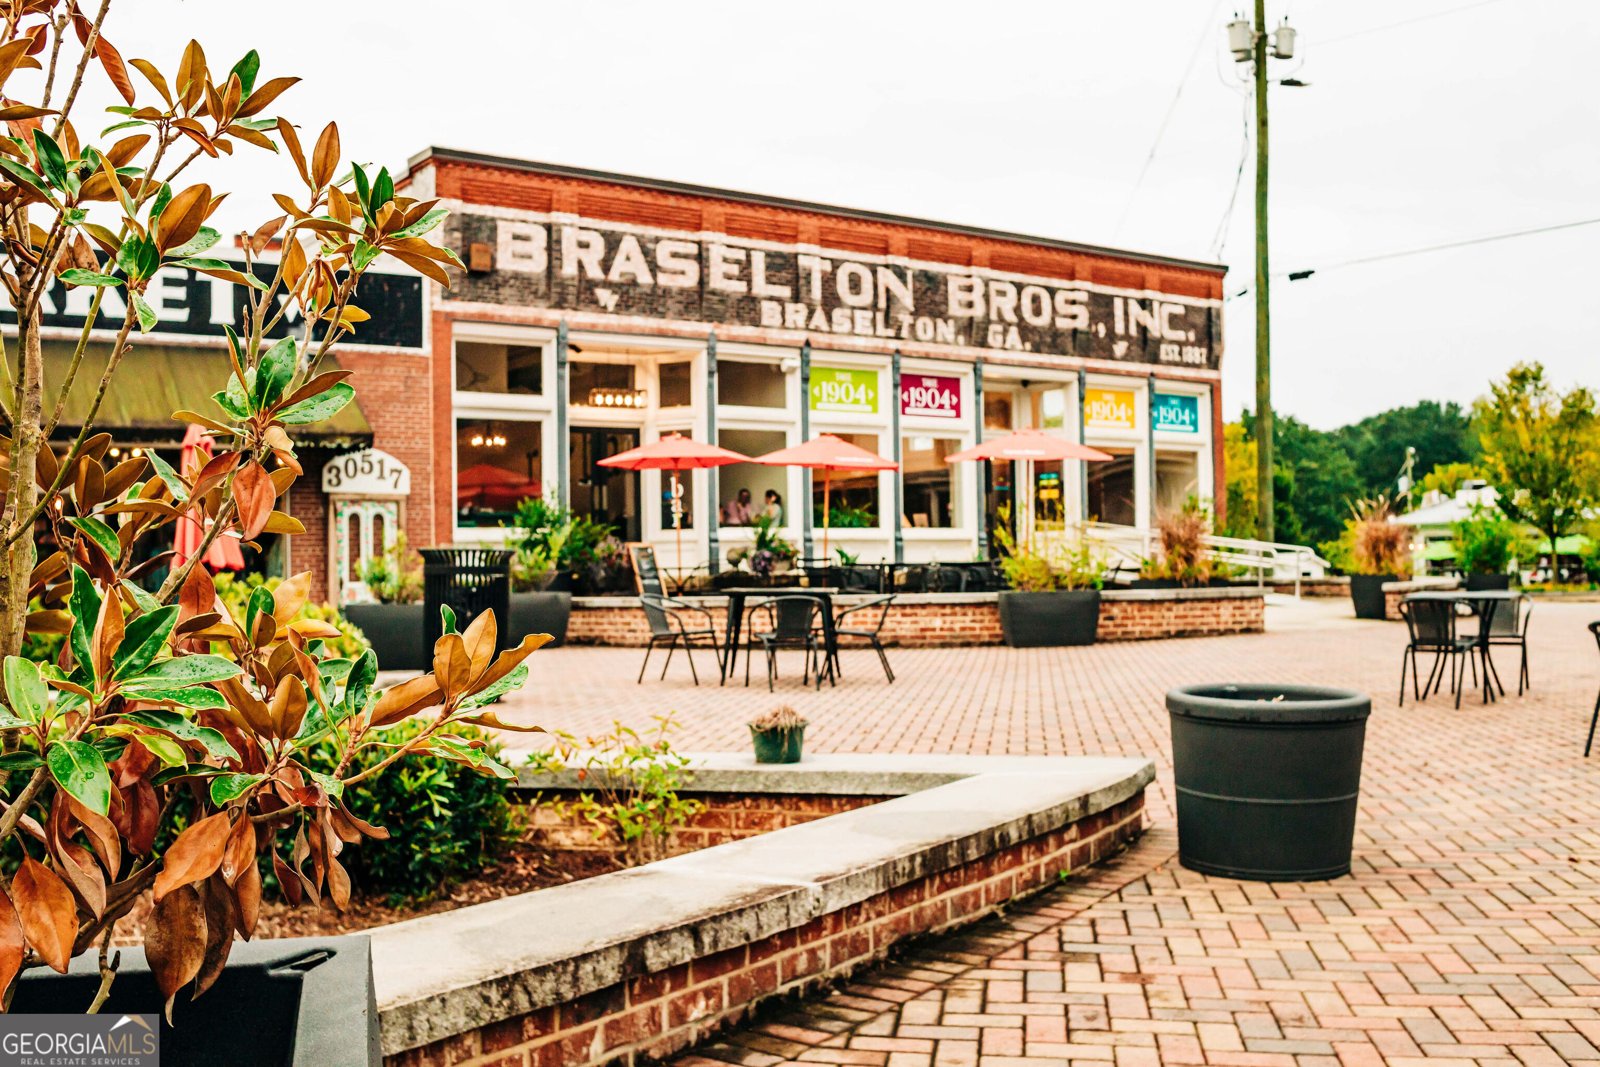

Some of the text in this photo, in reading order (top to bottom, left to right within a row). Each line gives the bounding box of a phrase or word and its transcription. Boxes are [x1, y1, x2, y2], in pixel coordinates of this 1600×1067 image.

[495, 219, 915, 312] BRASELTON
[1113, 296, 1195, 342] INC.
[987, 323, 1032, 351] GA.
[821, 381, 866, 404] 1904
[909, 387, 950, 410] 1904
[1092, 400, 1126, 421] 1904
[1159, 406, 1190, 425] 1904
[327, 454, 402, 489] 30517
